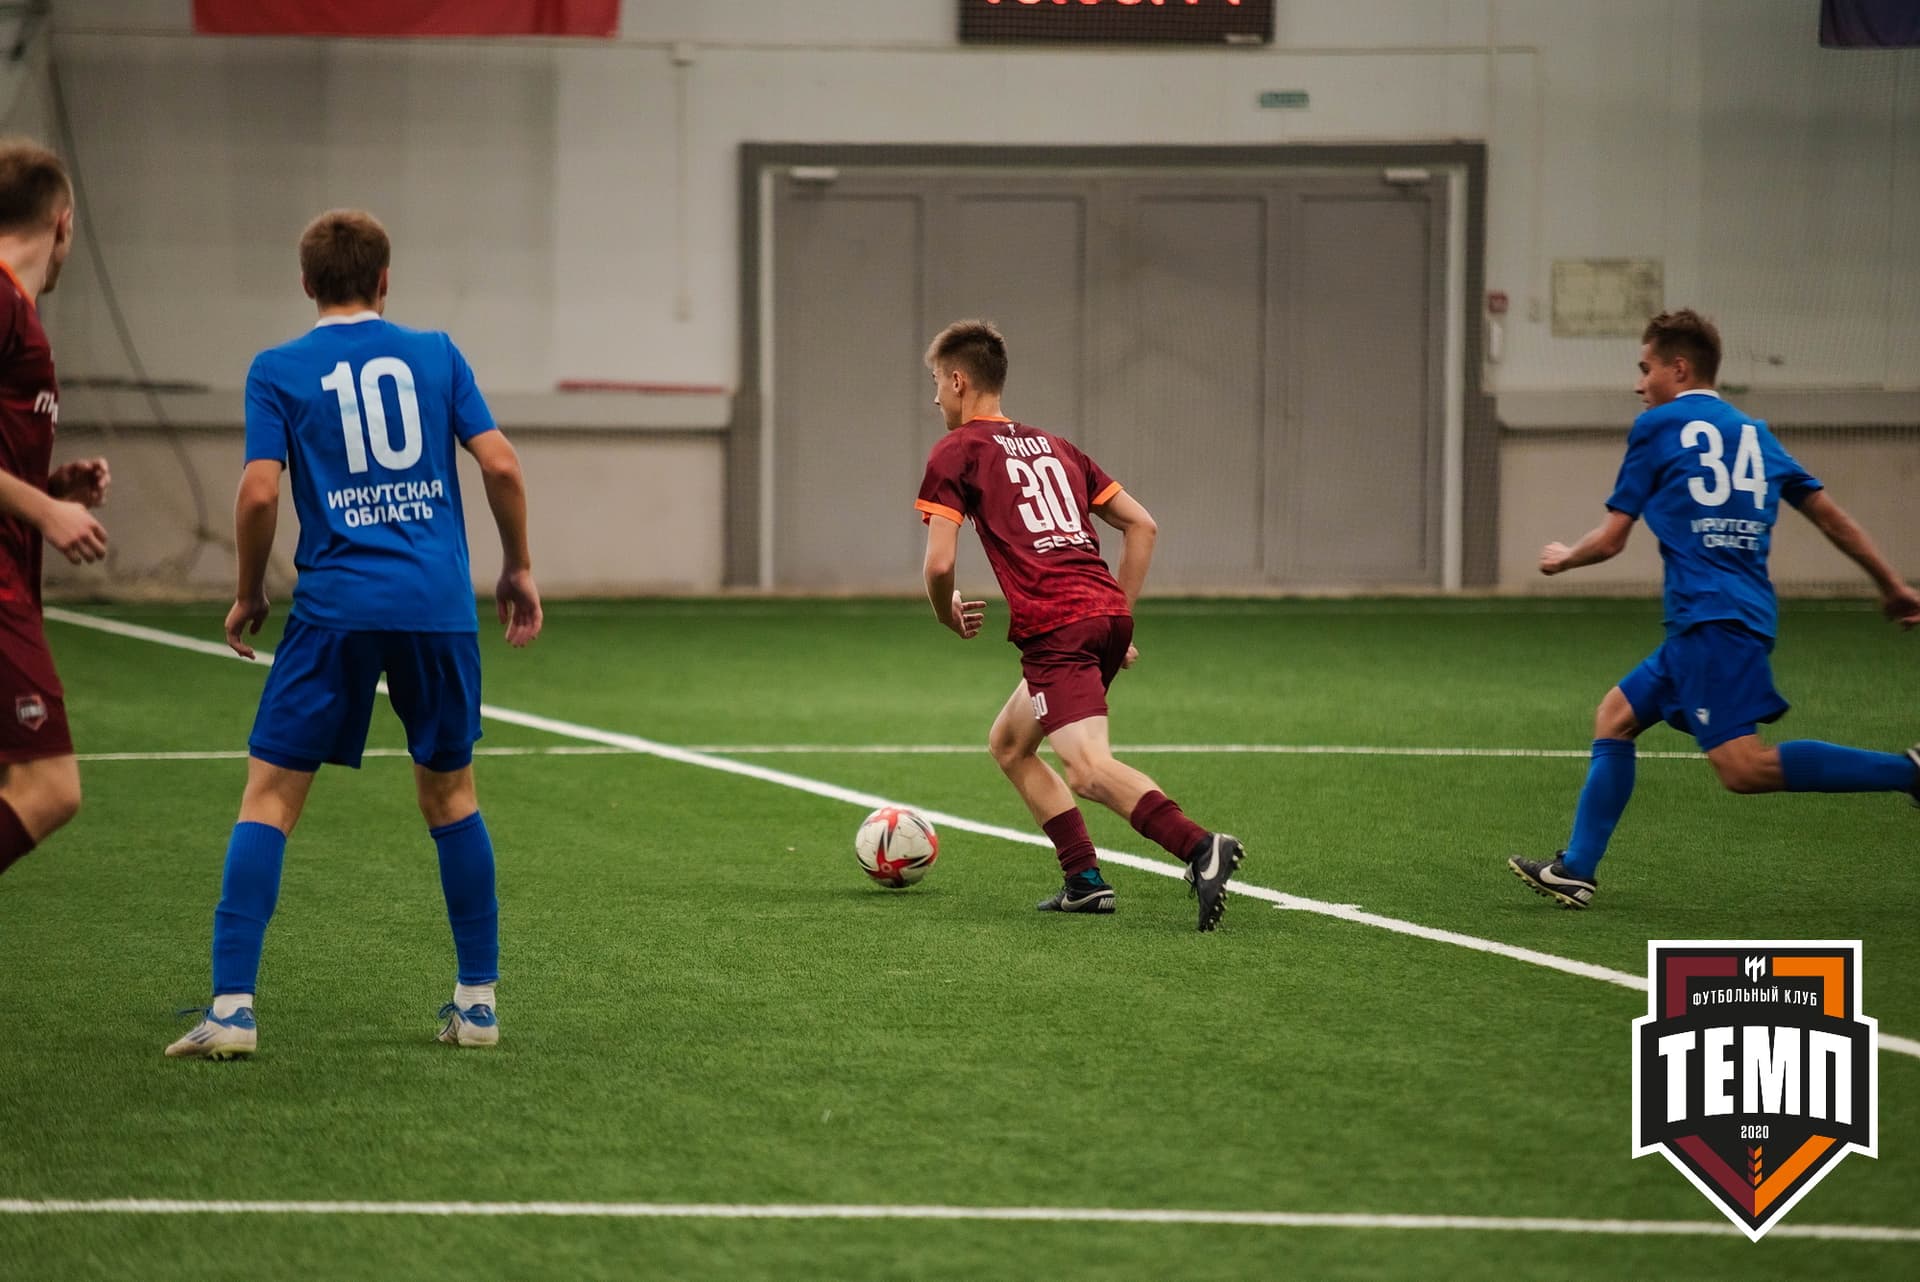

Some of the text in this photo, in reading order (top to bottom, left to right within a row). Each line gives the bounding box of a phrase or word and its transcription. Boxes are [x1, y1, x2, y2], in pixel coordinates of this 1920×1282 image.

[320, 356, 423, 474] 10
[327, 479, 444, 509] ИРКУТСКАЯ
[1005, 456, 1082, 533] 30
[1680, 420, 1768, 510] 34
[344, 501, 433, 528] ОБЛАСТЬ
